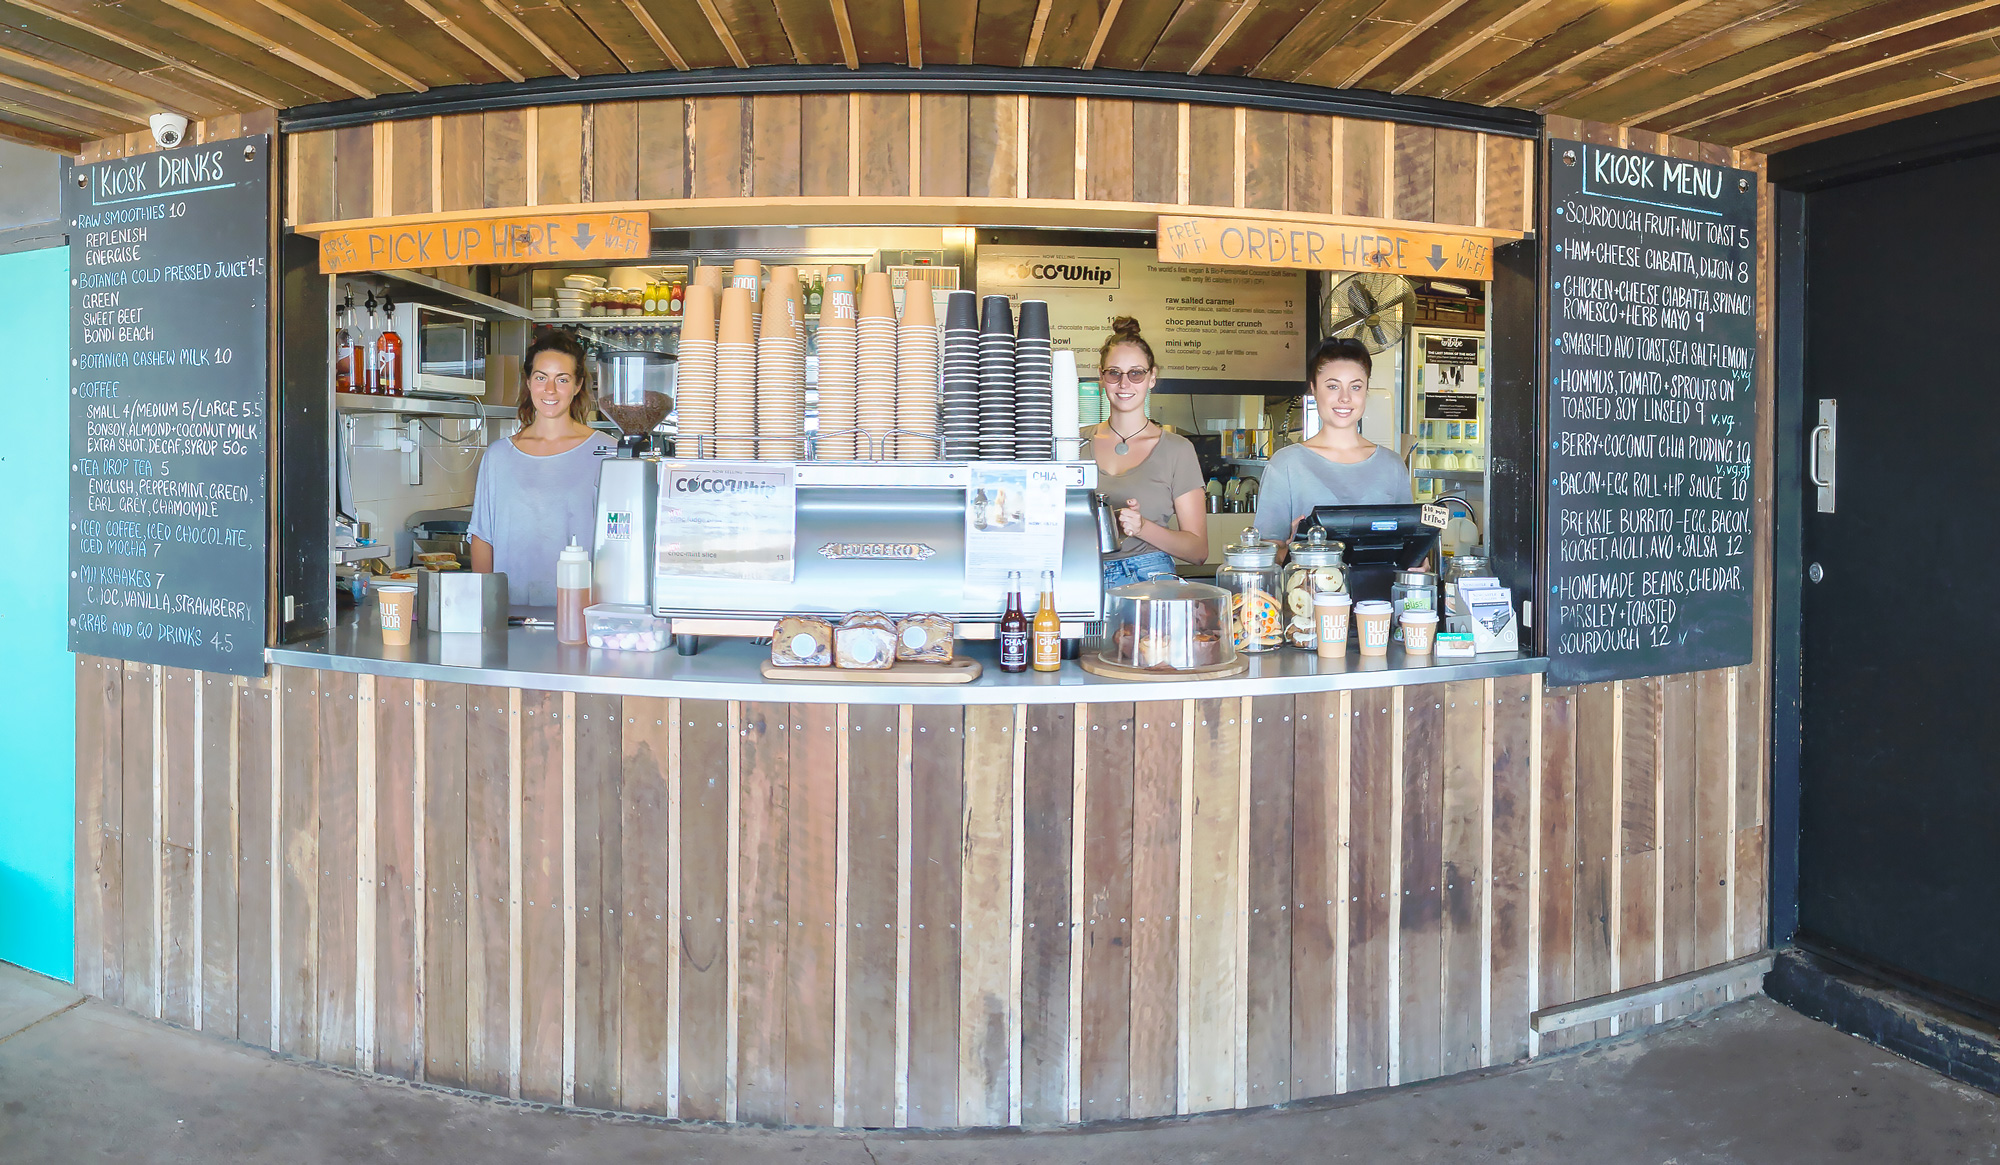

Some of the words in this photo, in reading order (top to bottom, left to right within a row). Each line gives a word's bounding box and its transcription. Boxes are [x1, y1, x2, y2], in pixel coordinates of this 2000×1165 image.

[101, 162, 147, 197] KIOSK
[159, 151, 223, 188] DRINKS
[1595, 149, 1654, 188] KIOSK
[1663, 161, 1722, 199] MENU
[78, 214, 101, 229] RAW
[103, 204, 165, 225] SMOOTHIES
[169, 202, 186, 218] 10
[609, 215, 643, 237] FREE
[1566, 201, 1641, 232] SOURDOUGH
[1705, 222, 1736, 246] TOAST
[1738, 229, 1749, 249] 5
[86, 227, 147, 247] REPLENISH
[1167, 220, 1200, 242] FREE
[324, 234, 352, 255] FREE
[369, 230, 433, 265] PICK
[442, 227, 481, 260] UP
[491, 223, 560, 258] HERE
[605, 232, 638, 255] WI-FI
[1220, 227, 1324, 264] ORDER
[1341, 233, 1409, 269] HERE
[1461, 238, 1488, 261] FREE
[86, 245, 141, 265] ENERGISE
[327, 249, 358, 271] WI-FI
[1456, 252, 1486, 277] WI-FI
[79, 270, 127, 289] BOTANICA
[132, 269, 160, 284] COLD
[164, 263, 211, 282] PRESSED
[215, 261, 247, 277] JUICE
[1700, 257, 1734, 280] DIJON
[1738, 262, 1748, 283] 8
[82, 292, 120, 308] GREEN
[82, 311, 114, 326] SWEET
[118, 308, 143, 323] BEET
[1661, 309, 1690, 331] MAYO
[1695, 312, 1704, 332] 9
[84, 328, 114, 343] BONDI
[119, 325, 154, 341] BEACH
[80, 351, 129, 369] BOTANICA
[133, 350, 175, 367] CASHEW
[180, 349, 210, 366] MILK
[215, 348, 232, 364] 10
[1561, 332, 1612, 357] SMASHED
[1614, 335, 1634, 358] AVO
[1670, 340, 1689, 364] SEA
[79, 381, 119, 398] COFFEE
[1720, 379, 1735, 401] ON
[87, 404, 120, 419] SMALL
[242, 402, 263, 417] 5.5
[1561, 396, 1610, 419] TOASTED
[1615, 397, 1638, 421] SOY
[1644, 398, 1690, 424] LINSEED
[1695, 402, 1704, 425] 9
[228, 423, 257, 440] MILK
[87, 438, 115, 453] EXTRA
[1659, 434, 1684, 459] CHIA
[1689, 436, 1734, 462] PUDDING
[1736, 440, 1751, 464] 10
[79, 459, 99, 476] TEA
[104, 459, 129, 475] DROP
[133, 459, 152, 476] TEA
[161, 461, 170, 476] 5
[1033, 472, 1057, 481] CHIA
[1689, 475, 1723, 500] SAUCE
[1731, 478, 1747, 501] 10
[89, 496, 115, 512] EARL
[152, 499, 218, 520] CHAMOMILE
[1561, 508, 1614, 536] BREKKIE
[1620, 508, 1673, 534] BURRITO
[80, 520, 100, 537] ICED
[147, 523, 171, 541] ICED
[175, 525, 253, 550] CHOCOLATE,
[1725, 535, 1744, 556] 12
[80, 540, 102, 554] ICED
[107, 540, 147, 557] MOCHA
[153, 543, 162, 558] 7
[156, 573, 165, 589] 7
[1560, 572, 1635, 600] HOMEMADE
[1323, 615, 1346, 627] BLUE
[1367, 620, 1390, 633] BLUE
[79, 614, 107, 633] GRAB
[112, 621, 132, 638] AND
[137, 622, 152, 640] GO
[158, 623, 202, 646] DRINKS
[210, 631, 234, 652] 4.5
[1325, 627, 1346, 640] DOOR
[1407, 627, 1427, 638] BLUE
[1408, 638, 1427, 647] DOOR
[1559, 628, 1639, 654] SOURDOUGH
[1650, 625, 1671, 648] 12
